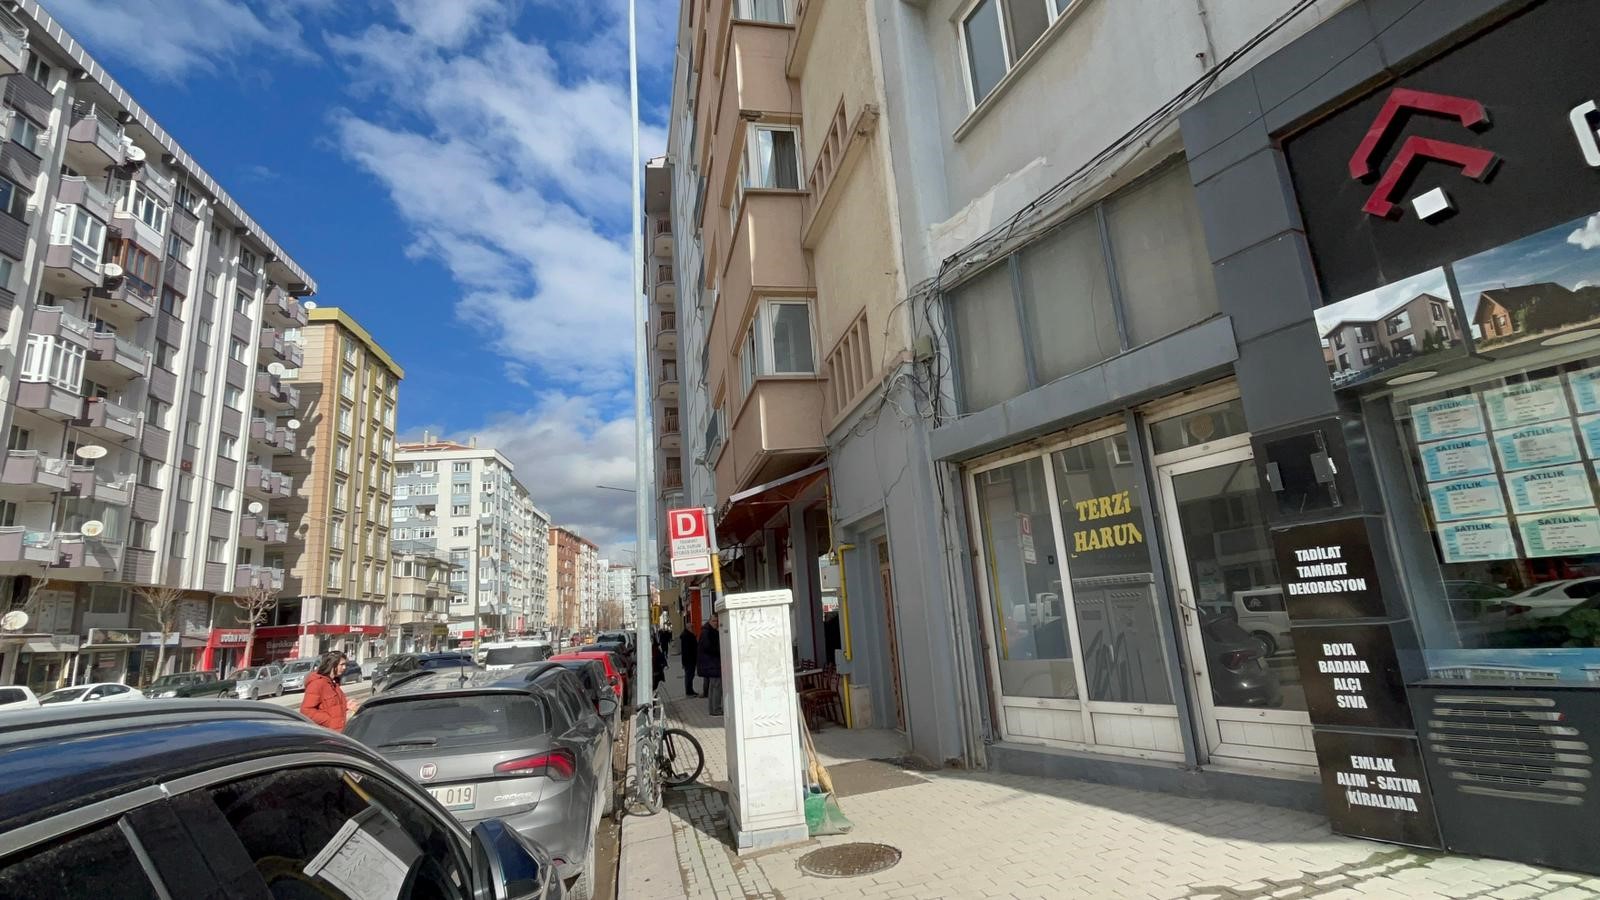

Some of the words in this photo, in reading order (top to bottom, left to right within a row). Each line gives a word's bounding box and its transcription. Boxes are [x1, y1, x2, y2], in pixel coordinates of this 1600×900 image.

[1426, 401, 1462, 412] SATILIK
[1512, 427, 1554, 440] SATILIK
[1435, 441, 1472, 452] SATILIK
[1523, 470, 1565, 482] SATILIK
[1445, 481, 1482, 492] SATILIK
[677, 513, 696, 536] D
[1454, 523, 1493, 533] SATILIK
[1537, 515, 1581, 526] SATILIK
[1073, 523, 1143, 552] HARUN
[1295, 546, 1341, 561] TADİLAT
[1296, 562, 1347, 578] TAMİRAT
[1288, 578, 1367, 595] DEKORASYON
[1322, 643, 1357, 656] BOYA
[1318, 660, 1370, 673] BADANA
[1333, 677, 1362, 693] ALÇI
[1336, 694, 1368, 709] SIVA
[1350, 755, 1396, 772] EMLAK
[1337, 771, 1368, 788] ALIM
[1377, 775, 1421, 794] SATIM
[446, 787, 472, 804] 019
[1347, 789, 1418, 812] KİRALAMA
